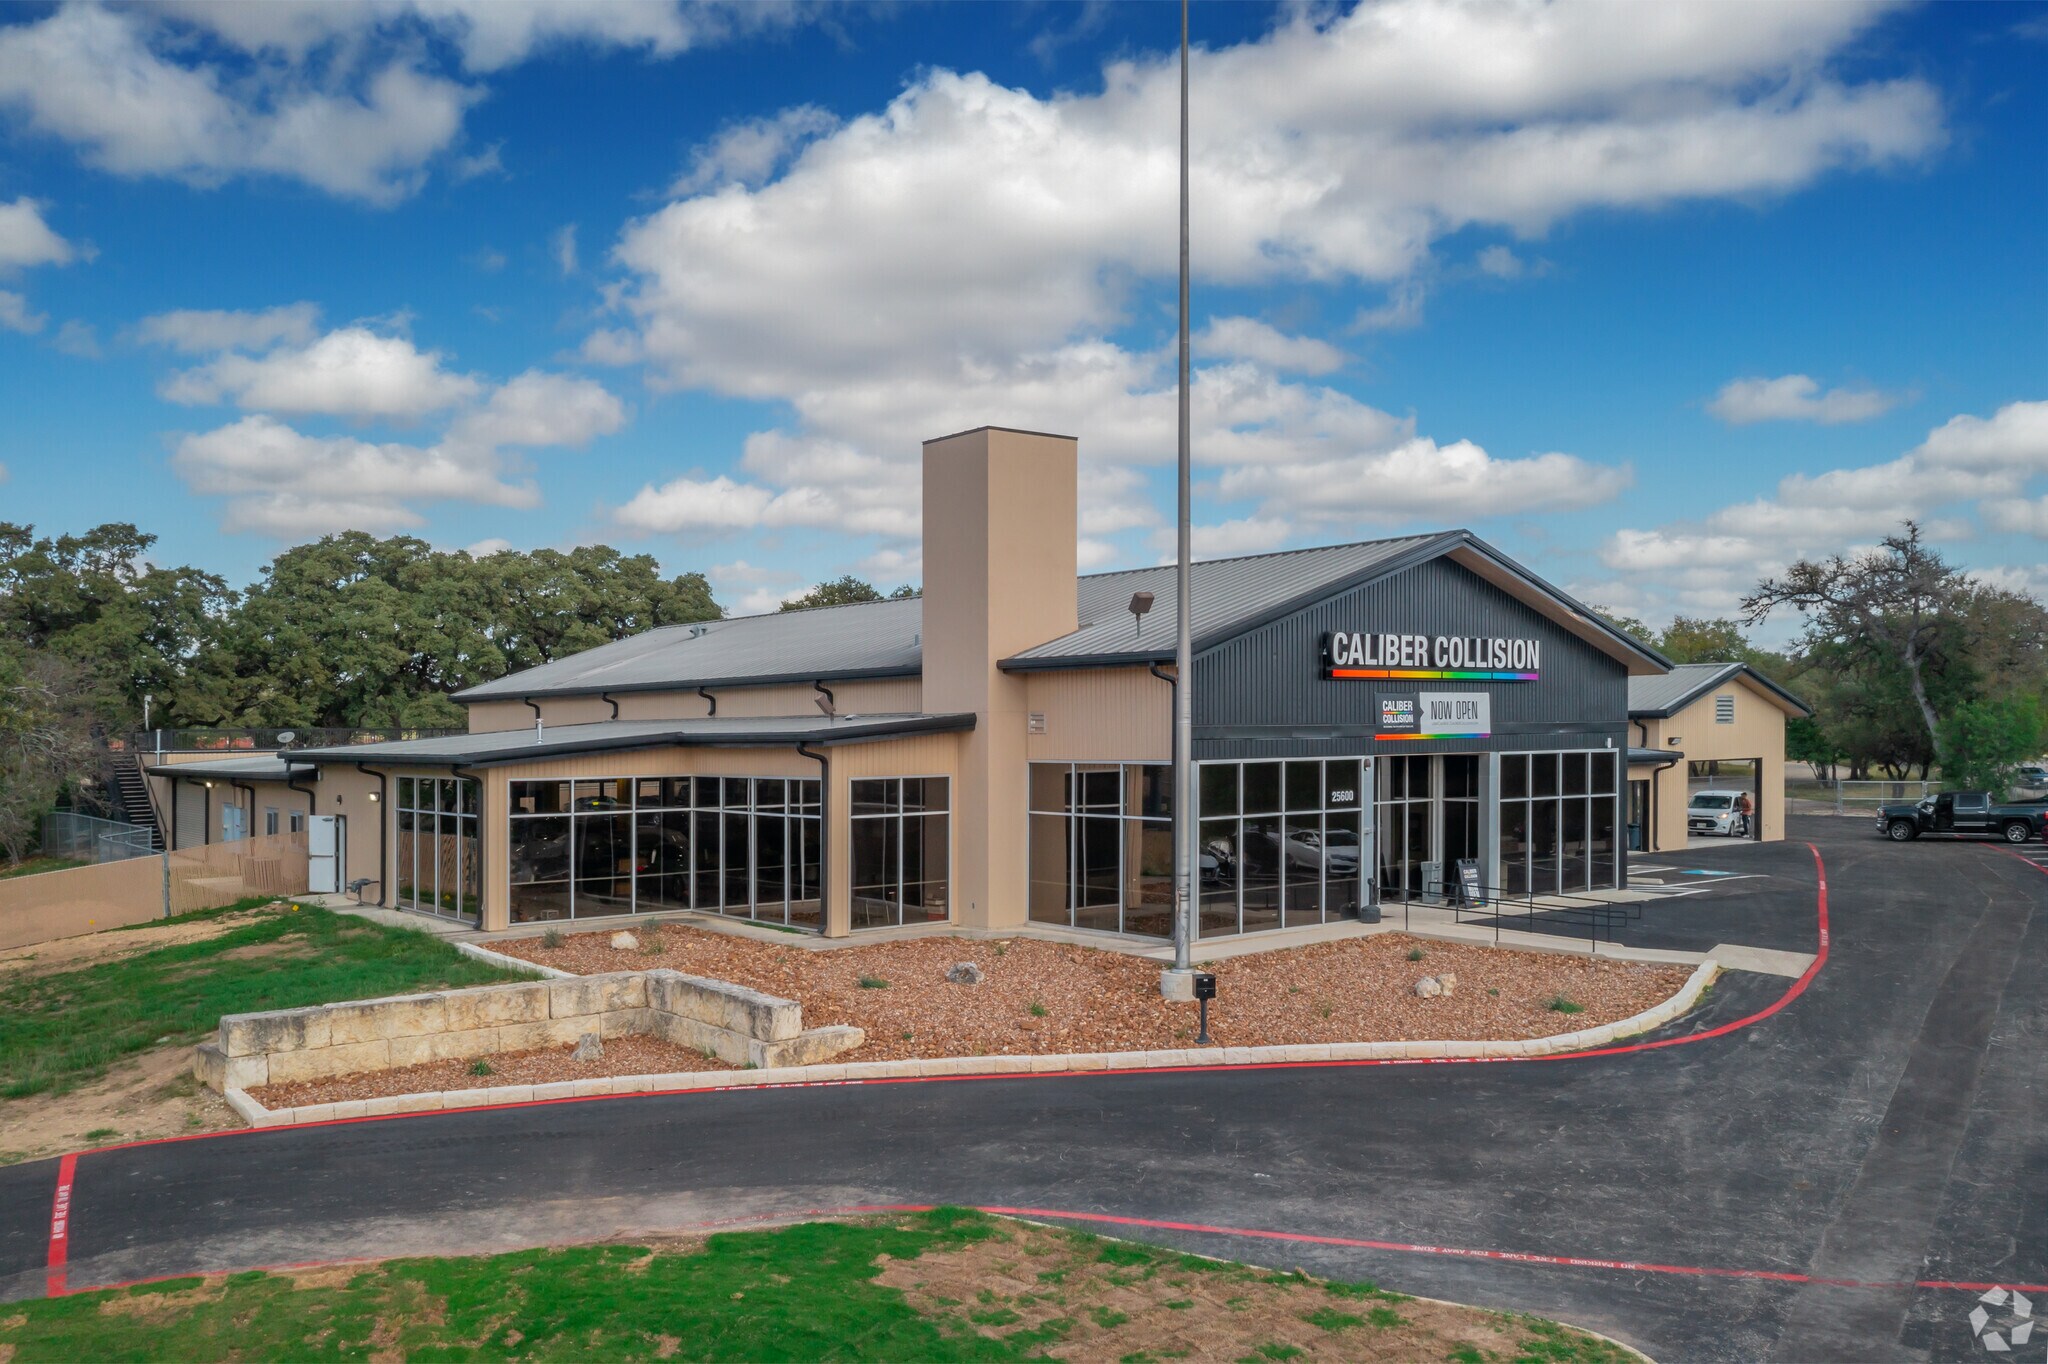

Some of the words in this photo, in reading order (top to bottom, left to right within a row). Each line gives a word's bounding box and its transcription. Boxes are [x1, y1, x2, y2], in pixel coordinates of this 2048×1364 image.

[1333, 631, 1428, 667] CALIBER
[1434, 636, 1540, 670] COLLISION
[1382, 700, 1413, 711] CALIBER
[1431, 701, 1452, 720] NOW
[1456, 700, 1478, 720] OPEN
[1383, 714, 1414, 723] COLLISION
[1331, 790, 1354, 802] 25600
[1499, 1252, 1527, 1260] LANE
[1533, 1255, 1557, 1263] FIRE
[1569, 1258, 1614, 1268] PARKING
